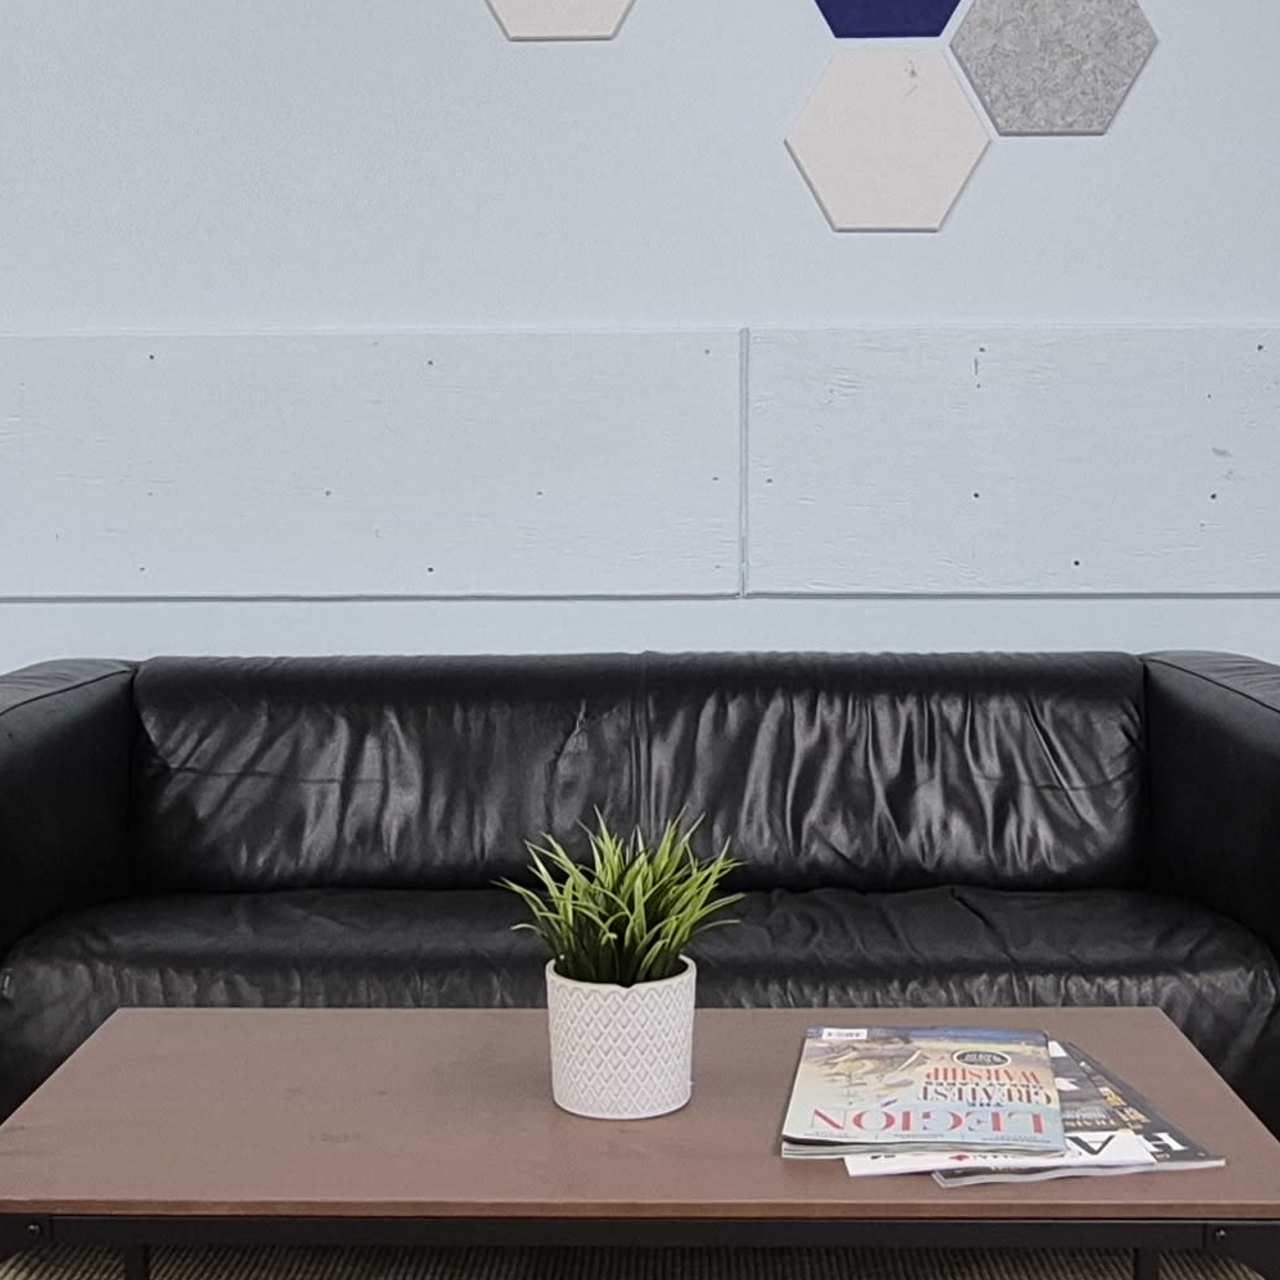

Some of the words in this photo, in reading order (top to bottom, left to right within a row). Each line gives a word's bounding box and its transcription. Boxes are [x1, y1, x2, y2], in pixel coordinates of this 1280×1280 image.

[925, 1067, 1041, 1085] WARSHIP
[920, 1085, 1053, 1106] GREATEST
[811, 1108, 1045, 1134] LEGION
